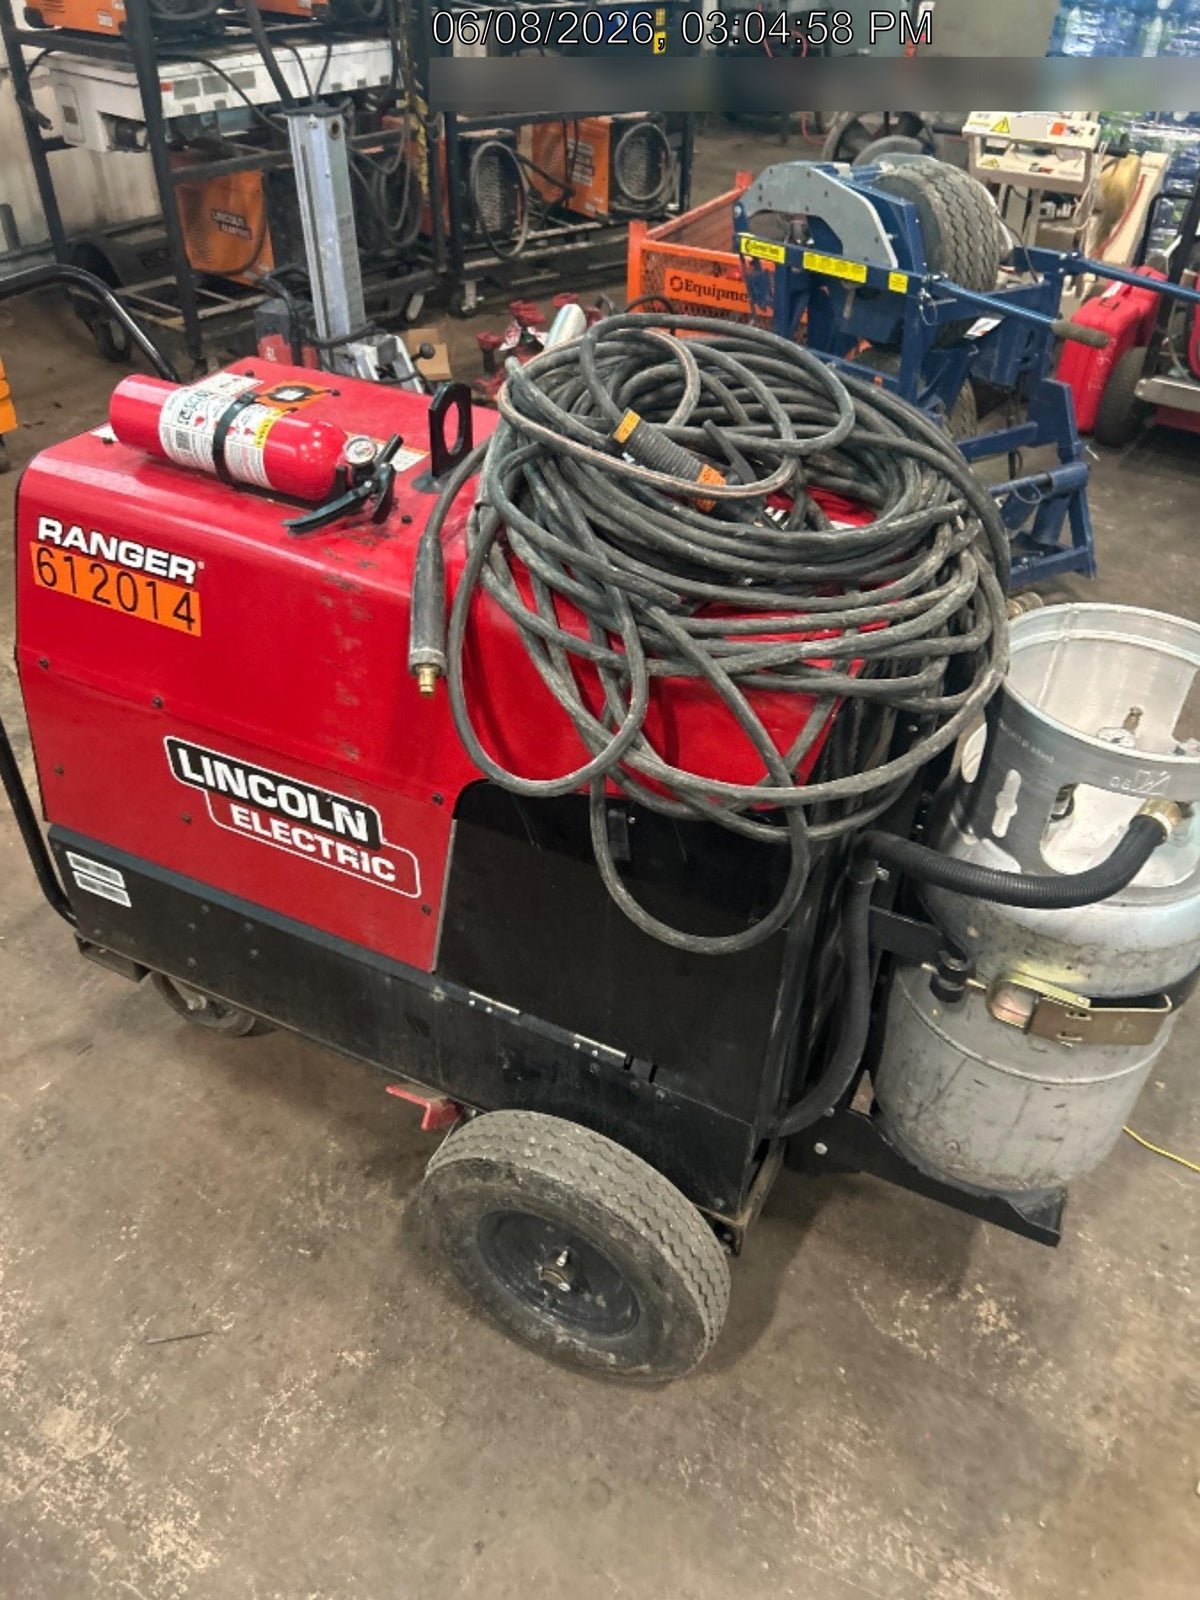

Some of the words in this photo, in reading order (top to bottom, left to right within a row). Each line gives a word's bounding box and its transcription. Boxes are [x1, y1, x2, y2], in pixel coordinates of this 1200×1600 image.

[36, 547, 196, 631] 612014
[38, 516, 196, 585] RANGER
[177, 747, 369, 843] LINCOLN
[230, 803, 396, 883] ELECTRIC
